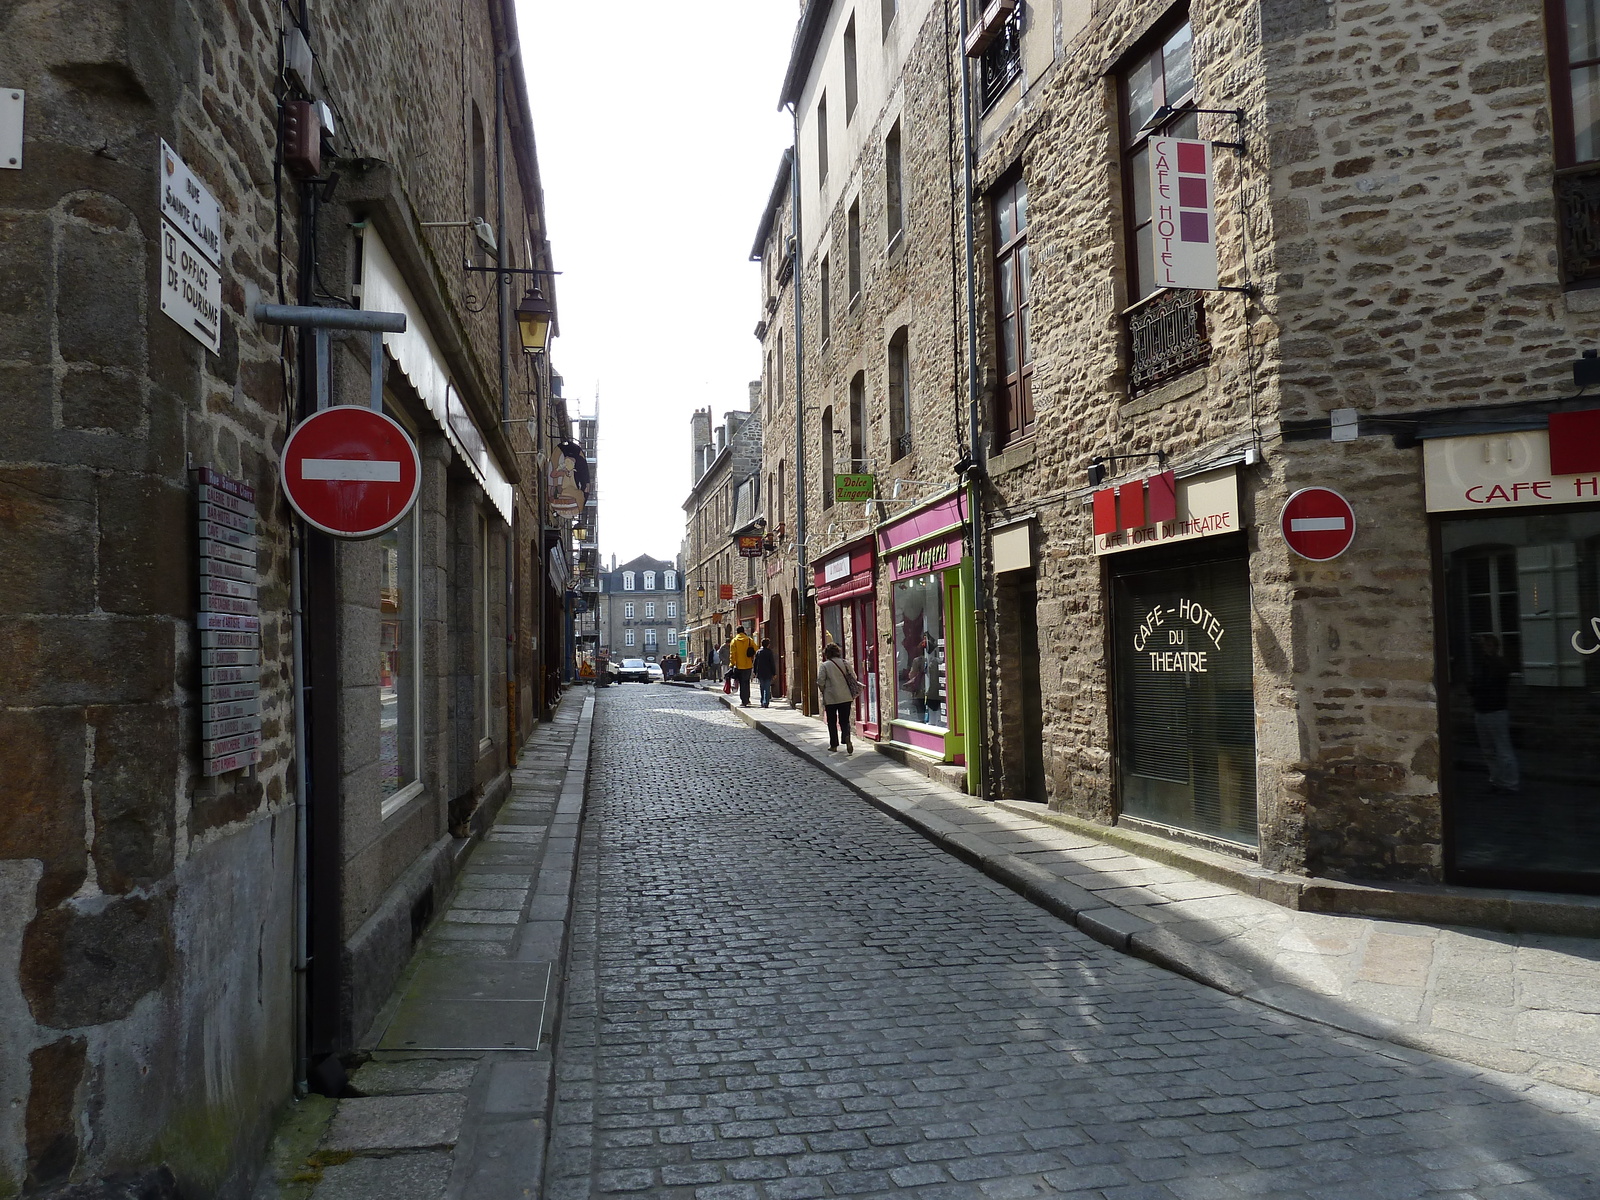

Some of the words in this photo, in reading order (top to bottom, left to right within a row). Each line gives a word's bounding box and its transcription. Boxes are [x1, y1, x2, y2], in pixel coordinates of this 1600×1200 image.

[1155, 141, 1171, 199] CAFE
[186, 177, 200, 204] RUE
[165, 185, 190, 225] SAINTE
[192, 210, 219, 254] CLAIRE
[1157, 205, 1176, 283] HOTEL
[181, 250, 208, 290] OFFICE
[167, 264, 178, 292] DE
[182, 278, 218, 326] TOURISME
[209, 470, 219, 486] Rue
[843, 476, 867, 487] Dolce
[207, 488, 225, 505] GALERIE
[837, 487, 872, 500] Lingerie
[1465, 481, 1552, 503] CAFE
[1099, 533, 1122, 551] CAFE
[1127, 526, 1158, 546] HOTEL
[1162, 523, 1177, 539] DU
[1179, 511, 1231, 537] THEATRE
[897, 551, 915, 574] Dolce
[916, 542, 948, 571] Lingerie
[217, 634, 252, 646] RESTAURANTS
[1168, 630, 1184, 645] DU
[1149, 651, 1208, 673] THEATRE
